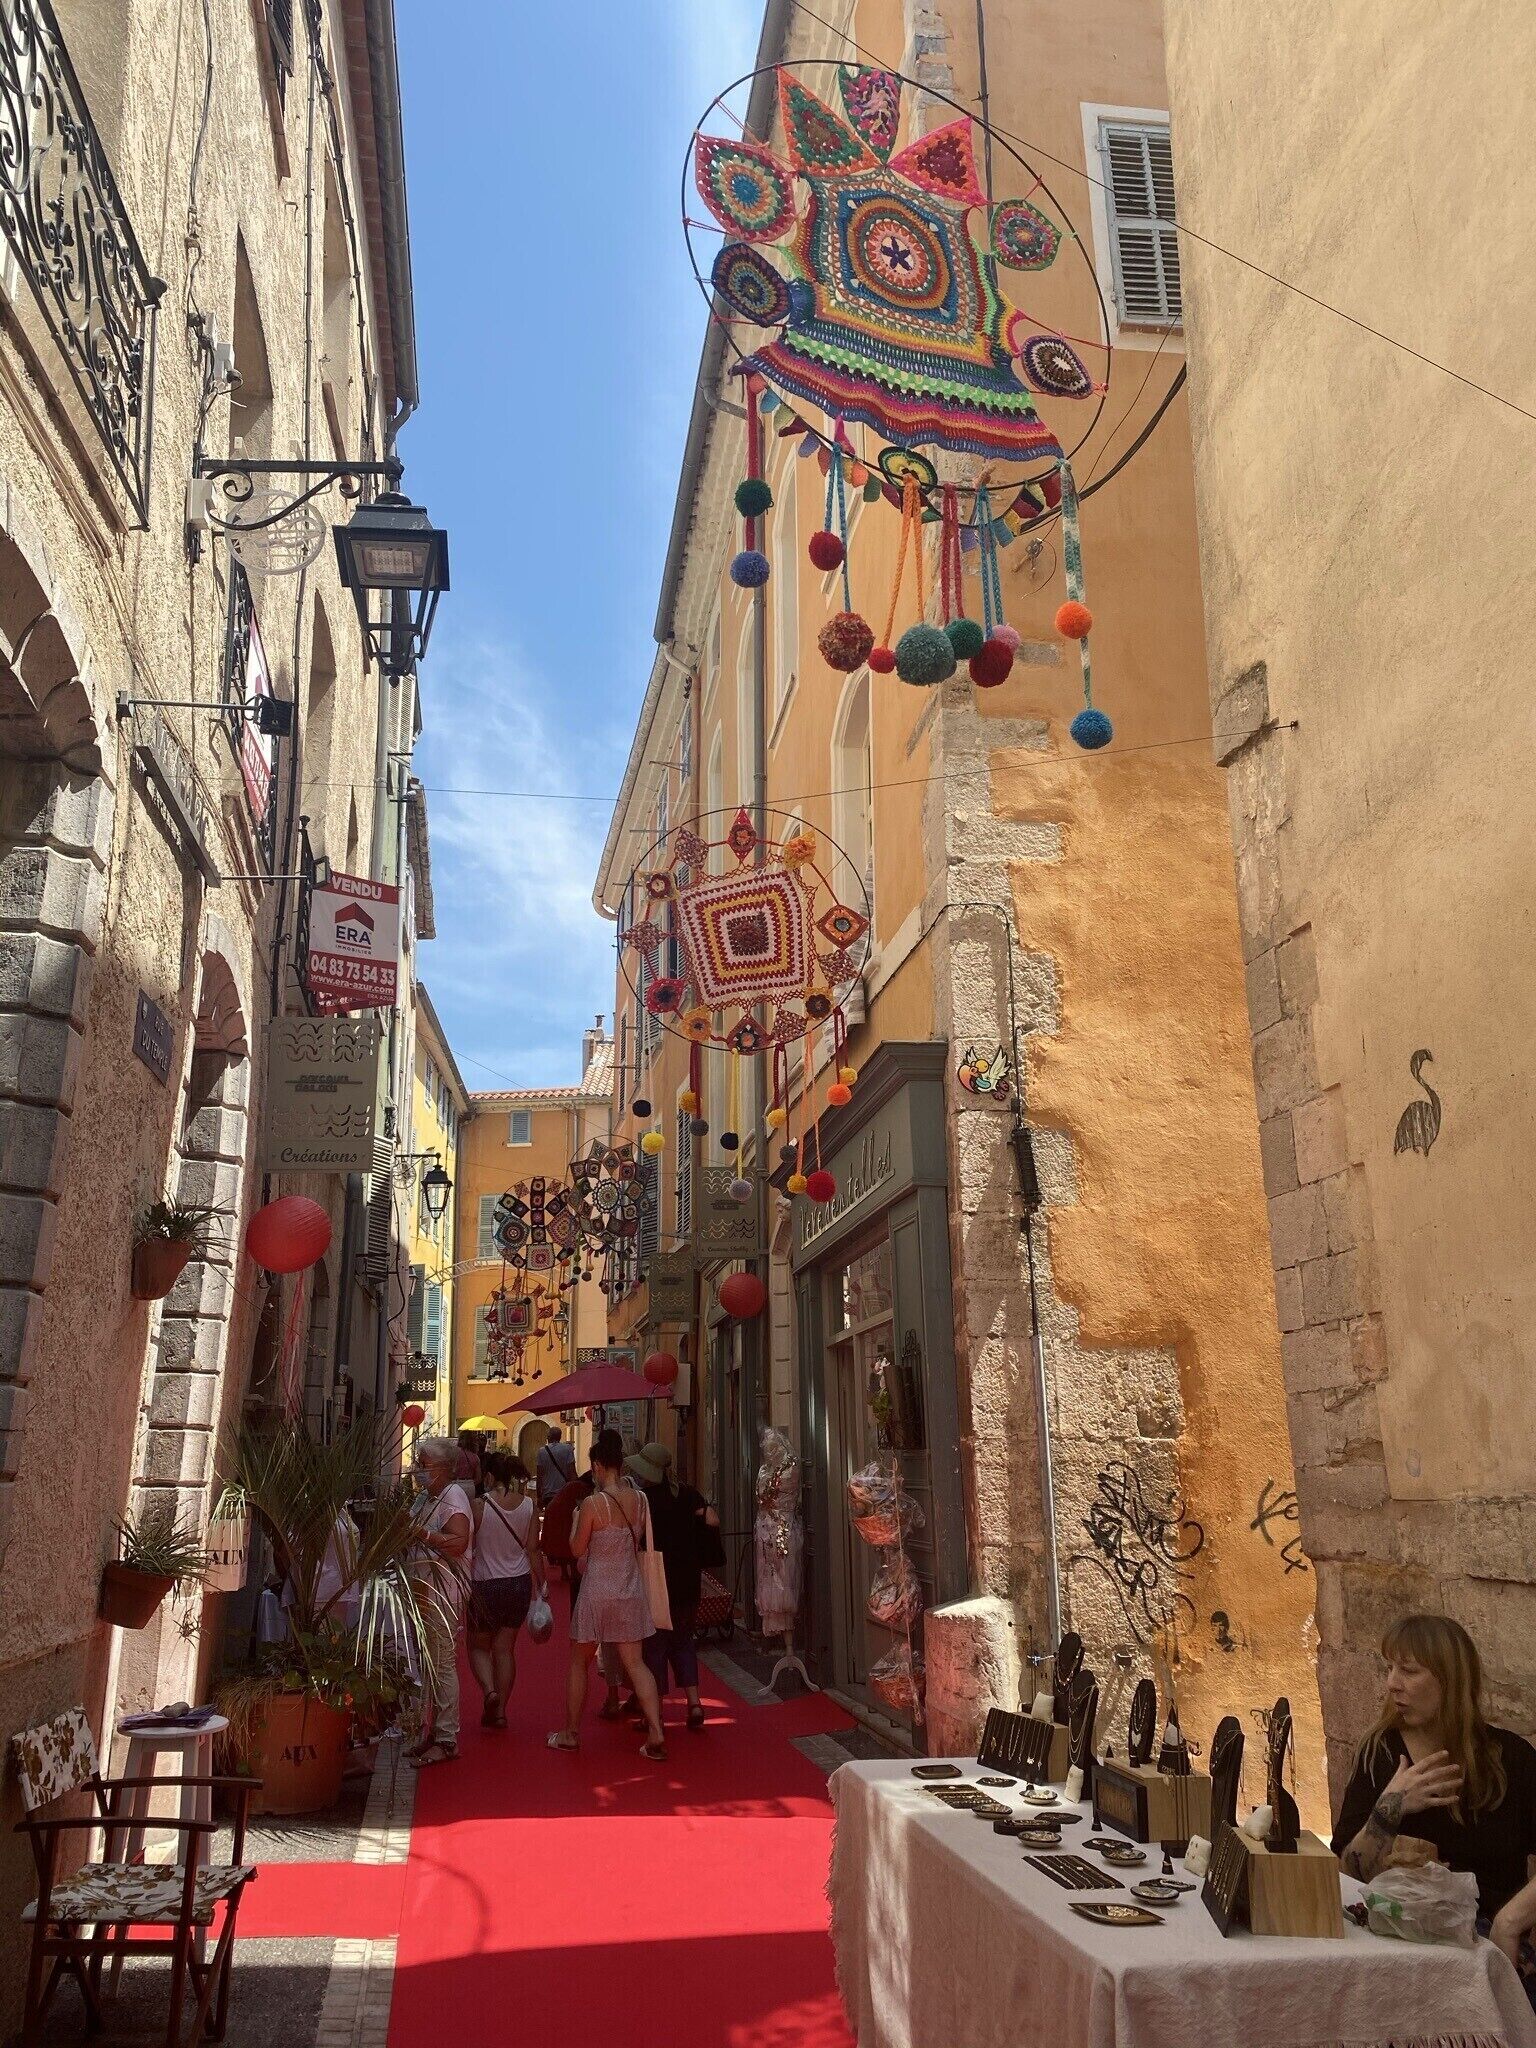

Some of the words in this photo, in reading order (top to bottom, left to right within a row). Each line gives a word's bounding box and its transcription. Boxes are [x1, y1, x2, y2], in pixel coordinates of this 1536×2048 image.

[331, 875, 382, 899] VENDU
[336, 925, 372, 946] ERA
[335, 943, 373, 956] IMMOBILIER
[311, 954, 328, 975] 04
[328, 957, 345, 978] 83
[346, 961, 361, 981] 73
[362, 964, 379, 984] 54
[379, 967, 396, 987] 33
[310, 973, 395, 995] www.era-azur.com
[280, 1146, 358, 1165] Créations
